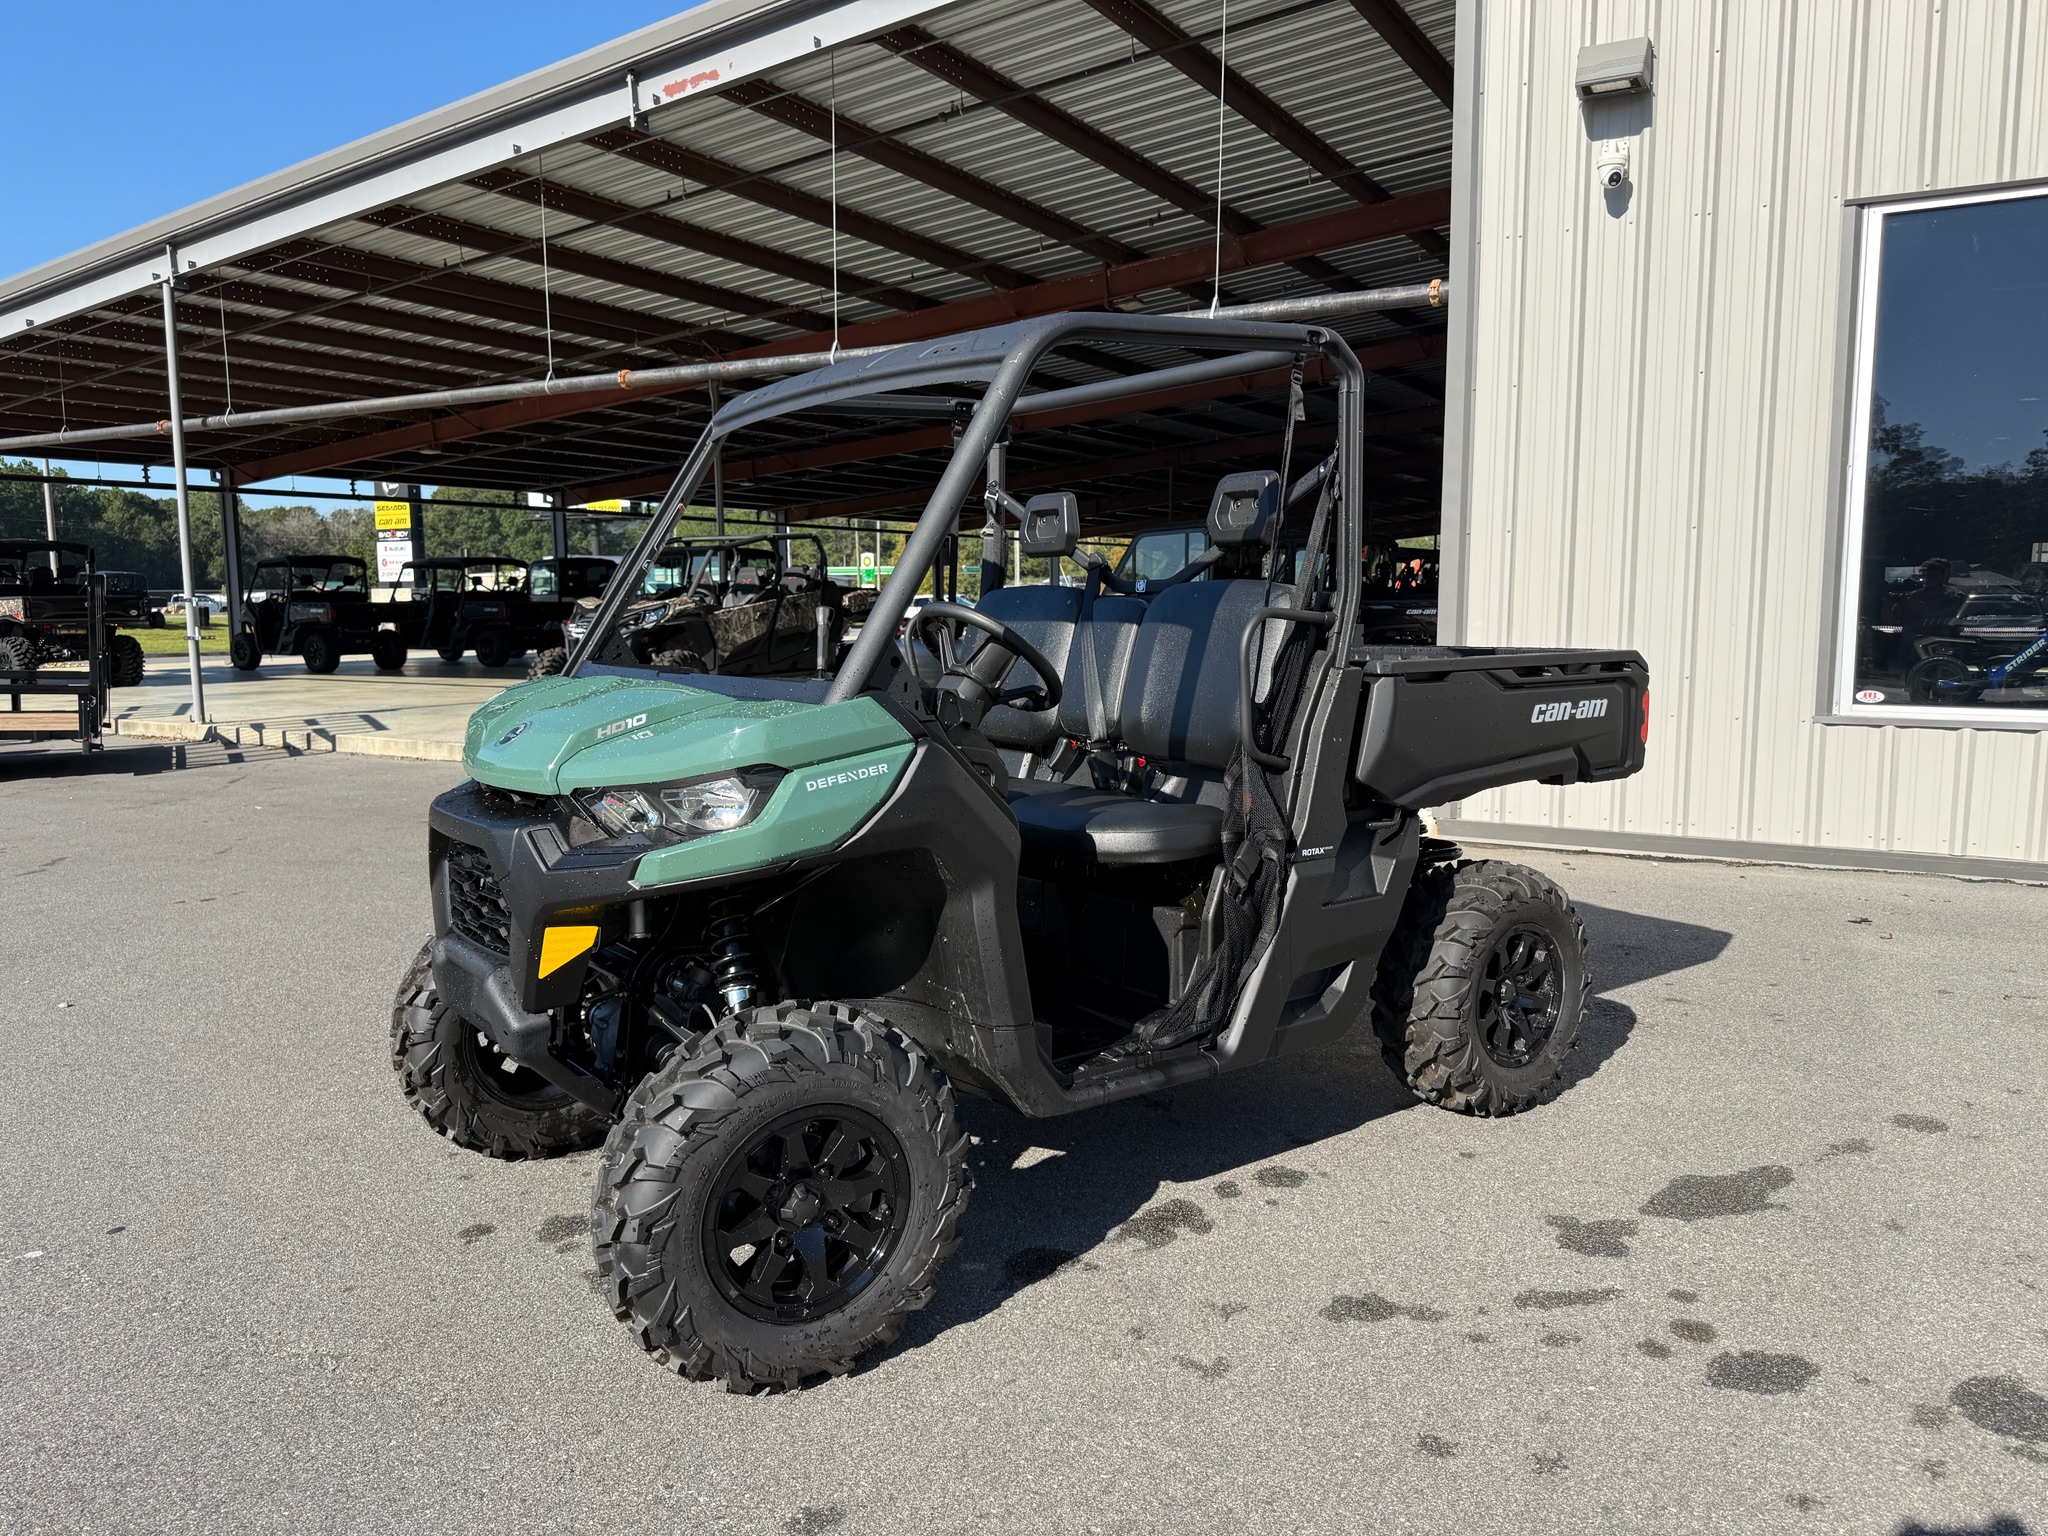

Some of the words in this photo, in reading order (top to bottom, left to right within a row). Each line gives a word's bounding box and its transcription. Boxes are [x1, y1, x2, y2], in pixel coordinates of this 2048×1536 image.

[2004, 638, 2047, 673] STRIDER
[1530, 698, 1608, 724] can-am
[596, 713, 647, 740] HD10
[806, 763, 889, 792] DEFENDER
[1302, 847, 1325, 857] ROTAX
